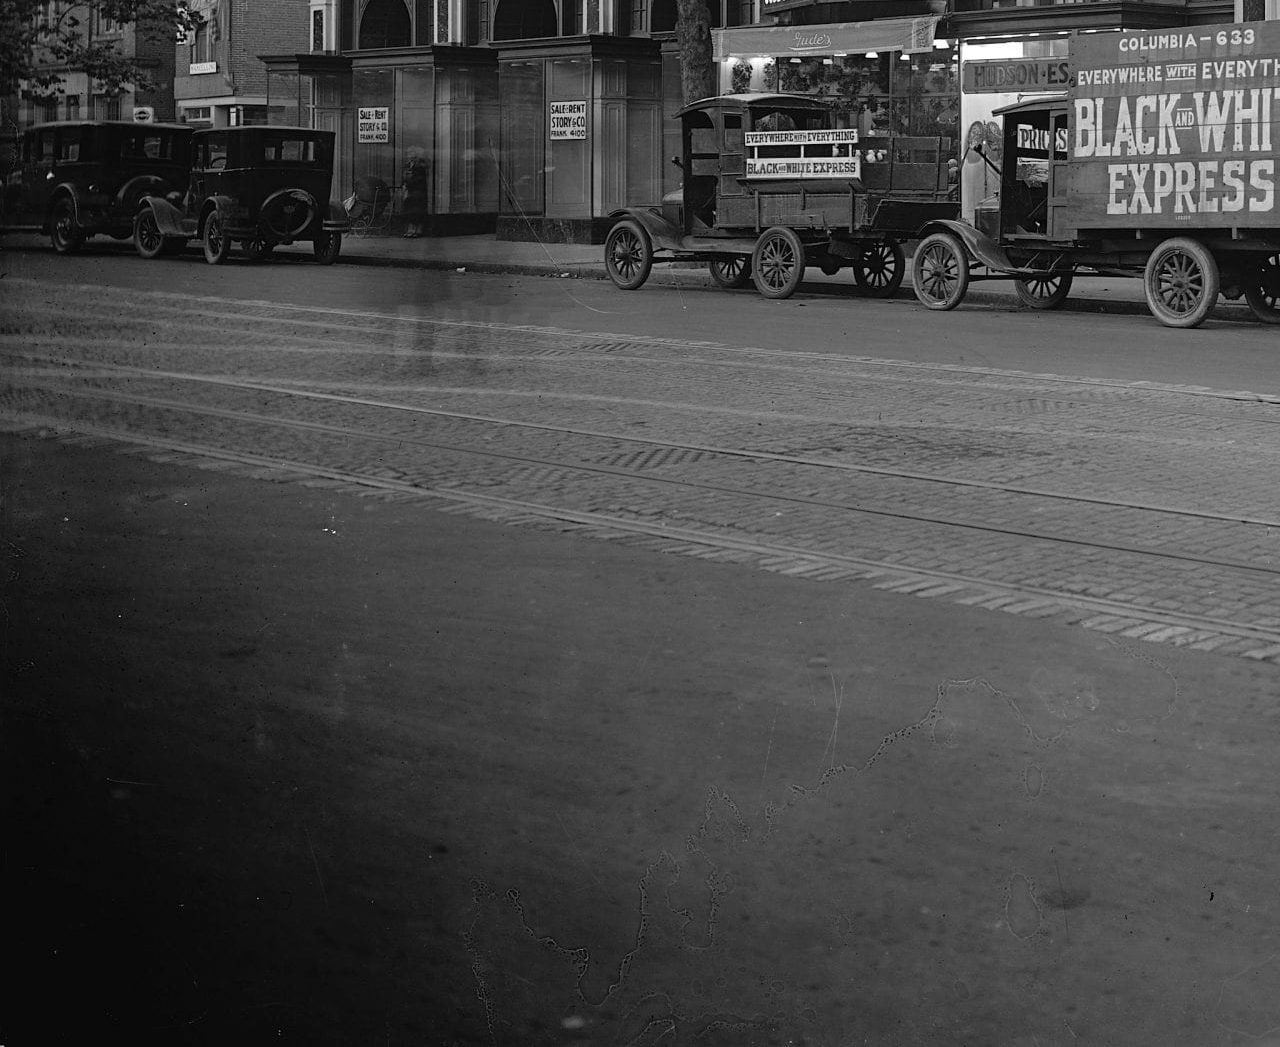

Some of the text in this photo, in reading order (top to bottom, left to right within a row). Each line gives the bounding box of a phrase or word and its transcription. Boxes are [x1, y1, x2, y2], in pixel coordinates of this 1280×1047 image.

[792, 32, 832, 47] Gude's
[1119, 33, 1197, 52] COLUMBIA
[1216, 29, 1255, 45] 633
[974, 63, 1039, 87] HUDSON
[1077, 65, 1162, 86] EVERYWHERE
[1166, 65, 1197, 78] WITH
[551, 104, 566, 114] SALE
[568, 103, 585, 113] RENT
[360, 122, 376, 132] STORY
[551, 116, 572, 128] STORY
[1073, 93, 1181, 157] BLACK
[1175, 111, 1194, 127] AND
[746, 133, 794, 144] EVERYWHERE
[807, 131, 855, 142] EVERYTHING
[1019, 127, 1068, 151] PRICS
[747, 162, 779, 174] BLACK
[786, 162, 811, 173] WHITE
[813, 161, 856, 173] EXPRESS
[1106, 159, 1275, 215] EXPRESS
